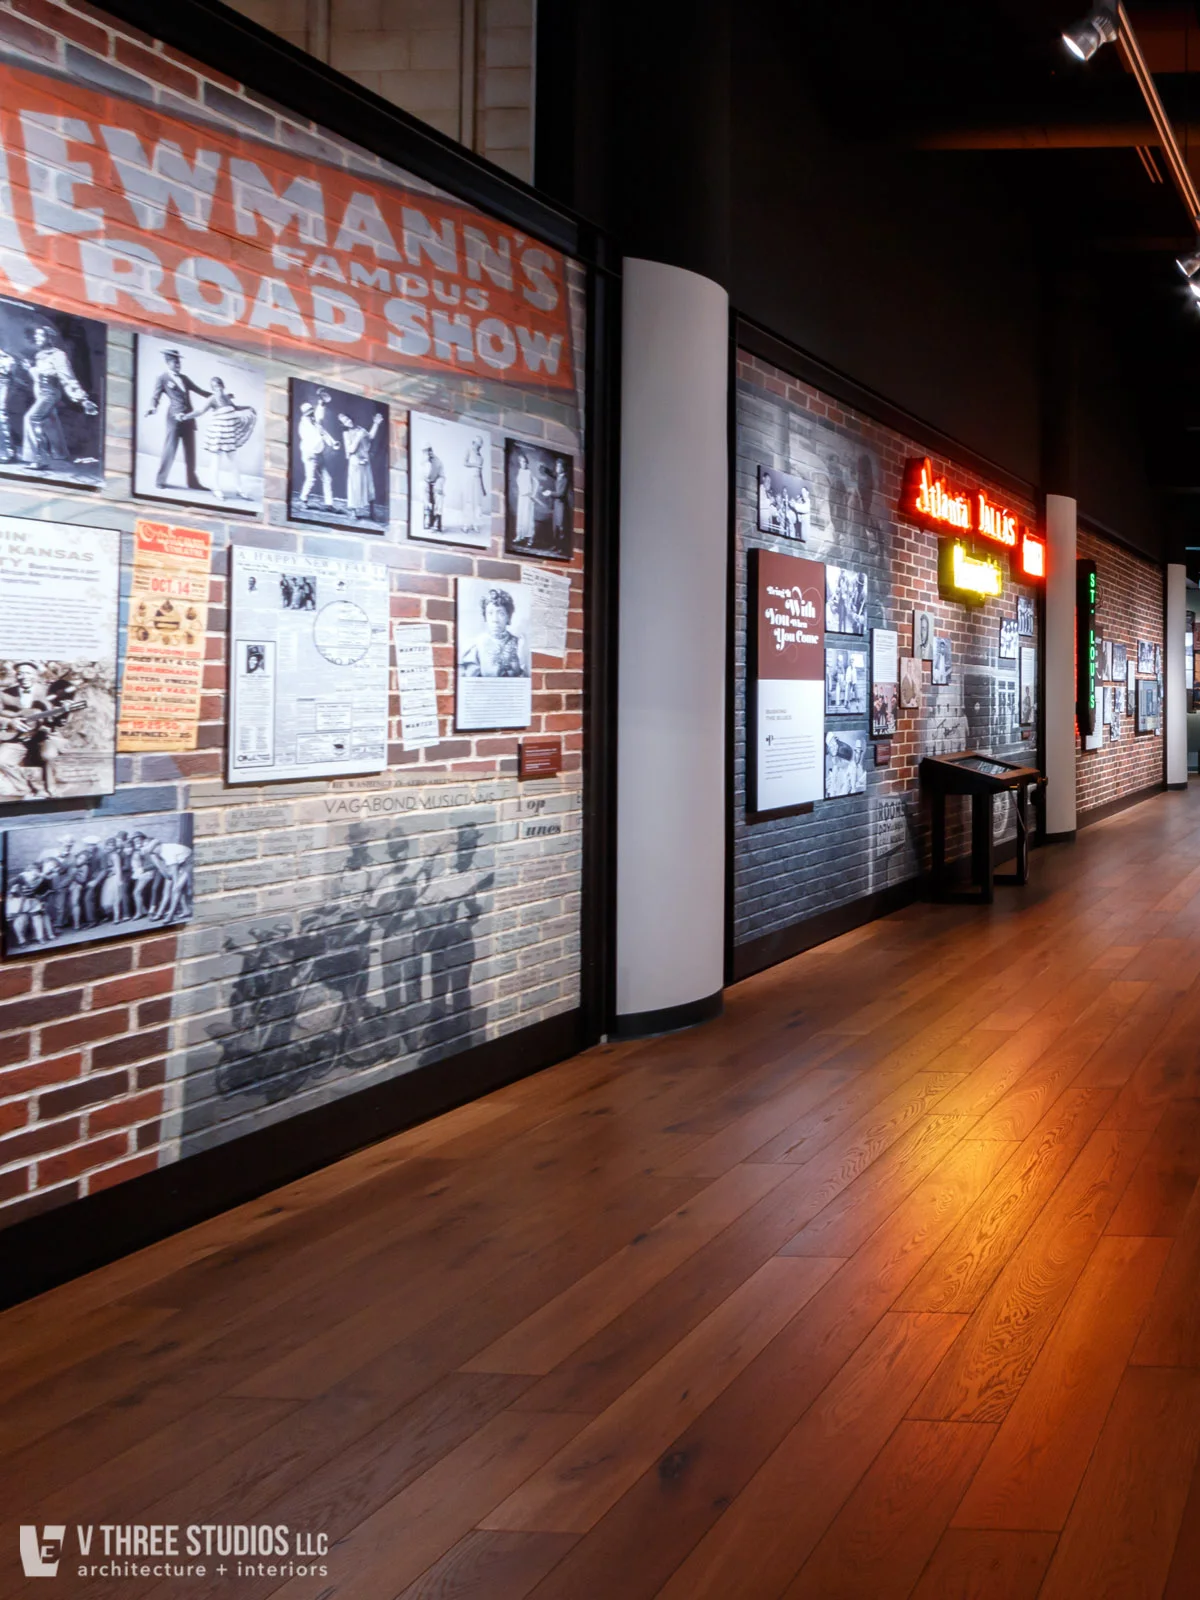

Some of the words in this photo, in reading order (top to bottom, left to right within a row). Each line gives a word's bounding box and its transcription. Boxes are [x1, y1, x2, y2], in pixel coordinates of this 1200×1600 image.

[0, 110, 559, 312] EWMANN'S
[272, 246, 490, 312] FAMOUS
[80, 237, 365, 345] ROAD
[383, 300, 565, 377] SHOW
[8, 545, 95, 562] KANSAS
[254, 552, 297, 565] HAPPY
[764, 607, 790, 626] You
[785, 593, 816, 618] With
[773, 628, 796, 650] You
[796, 630, 819, 644] Come
[324, 796, 416, 814] VAGABOND
[419, 791, 495, 809] MUSICIANS
